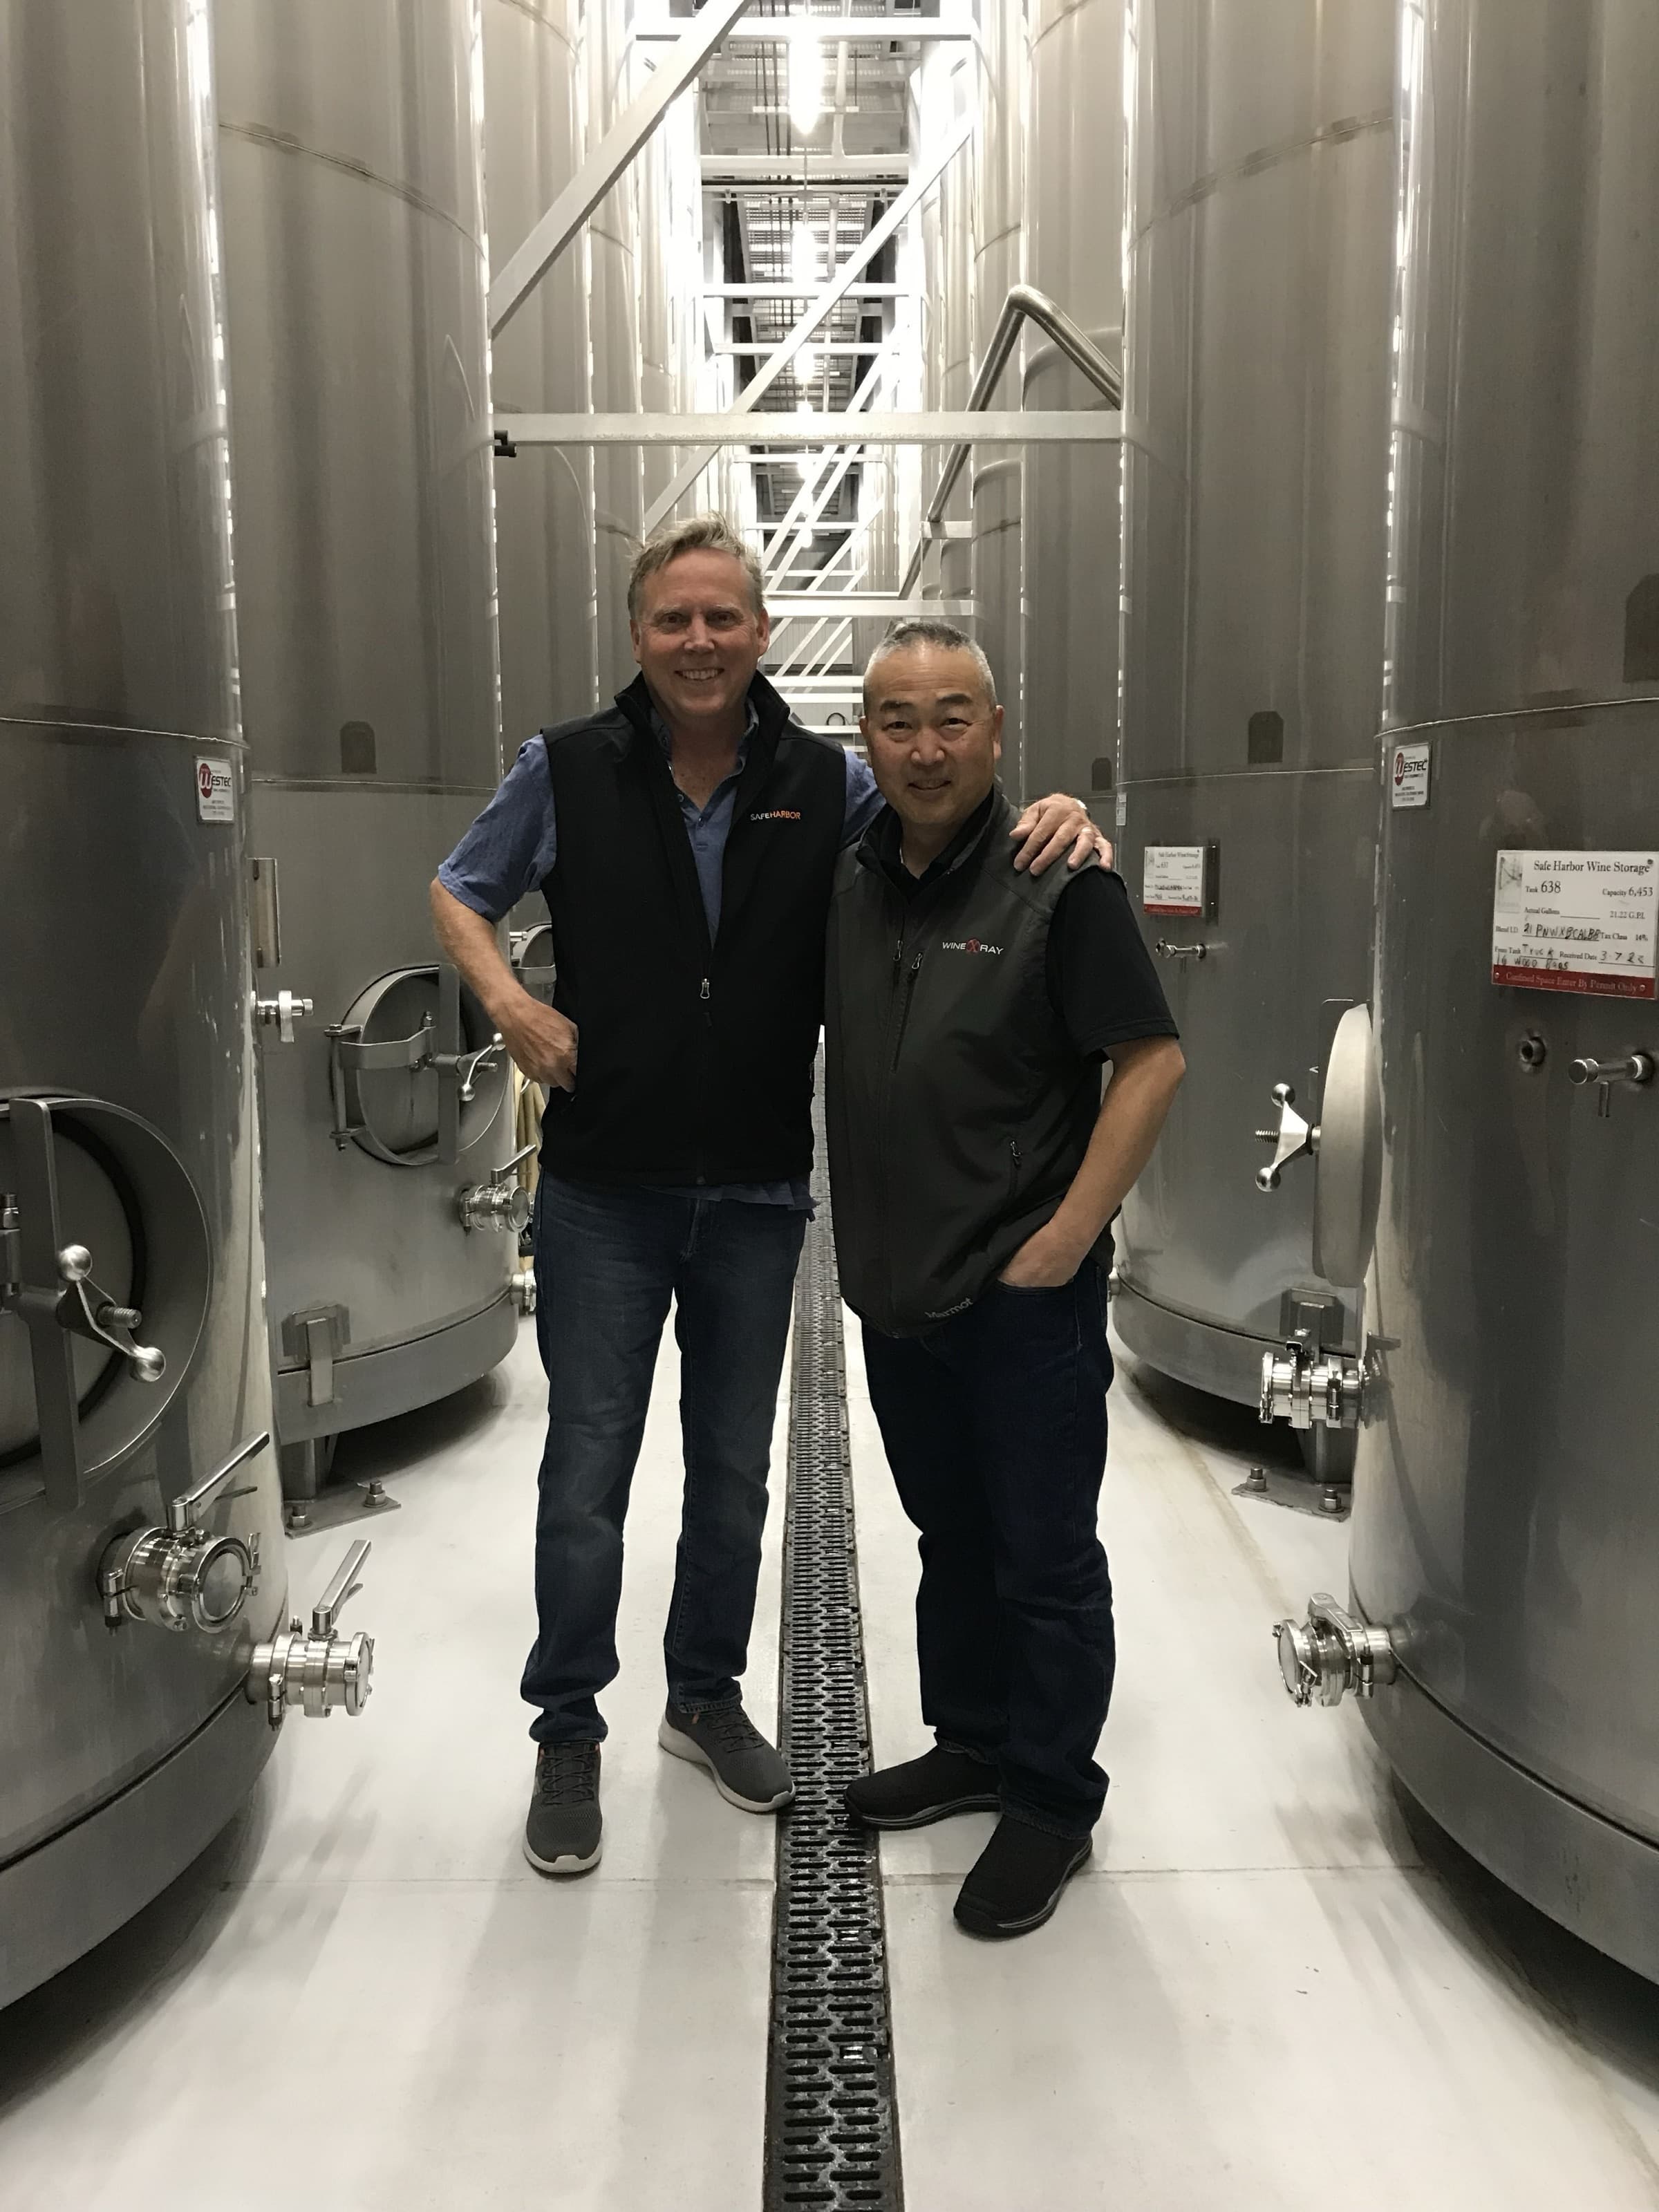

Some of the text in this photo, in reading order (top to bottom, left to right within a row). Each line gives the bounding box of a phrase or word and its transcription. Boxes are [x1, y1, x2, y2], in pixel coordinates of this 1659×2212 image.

[1395, 758, 1428, 779] WESTEC
[199, 770, 232, 792] WESTEC
[1533, 860, 1651, 876] Safe Harbor Wine Storage
[1541, 880, 1562, 894] 638
[1602, 886, 1653, 898] Capacity 6,453
[942, 941, 966, 950] WINE
[1557, 977, 1576, 987] Enter
[1618, 981, 1637, 995] Only
